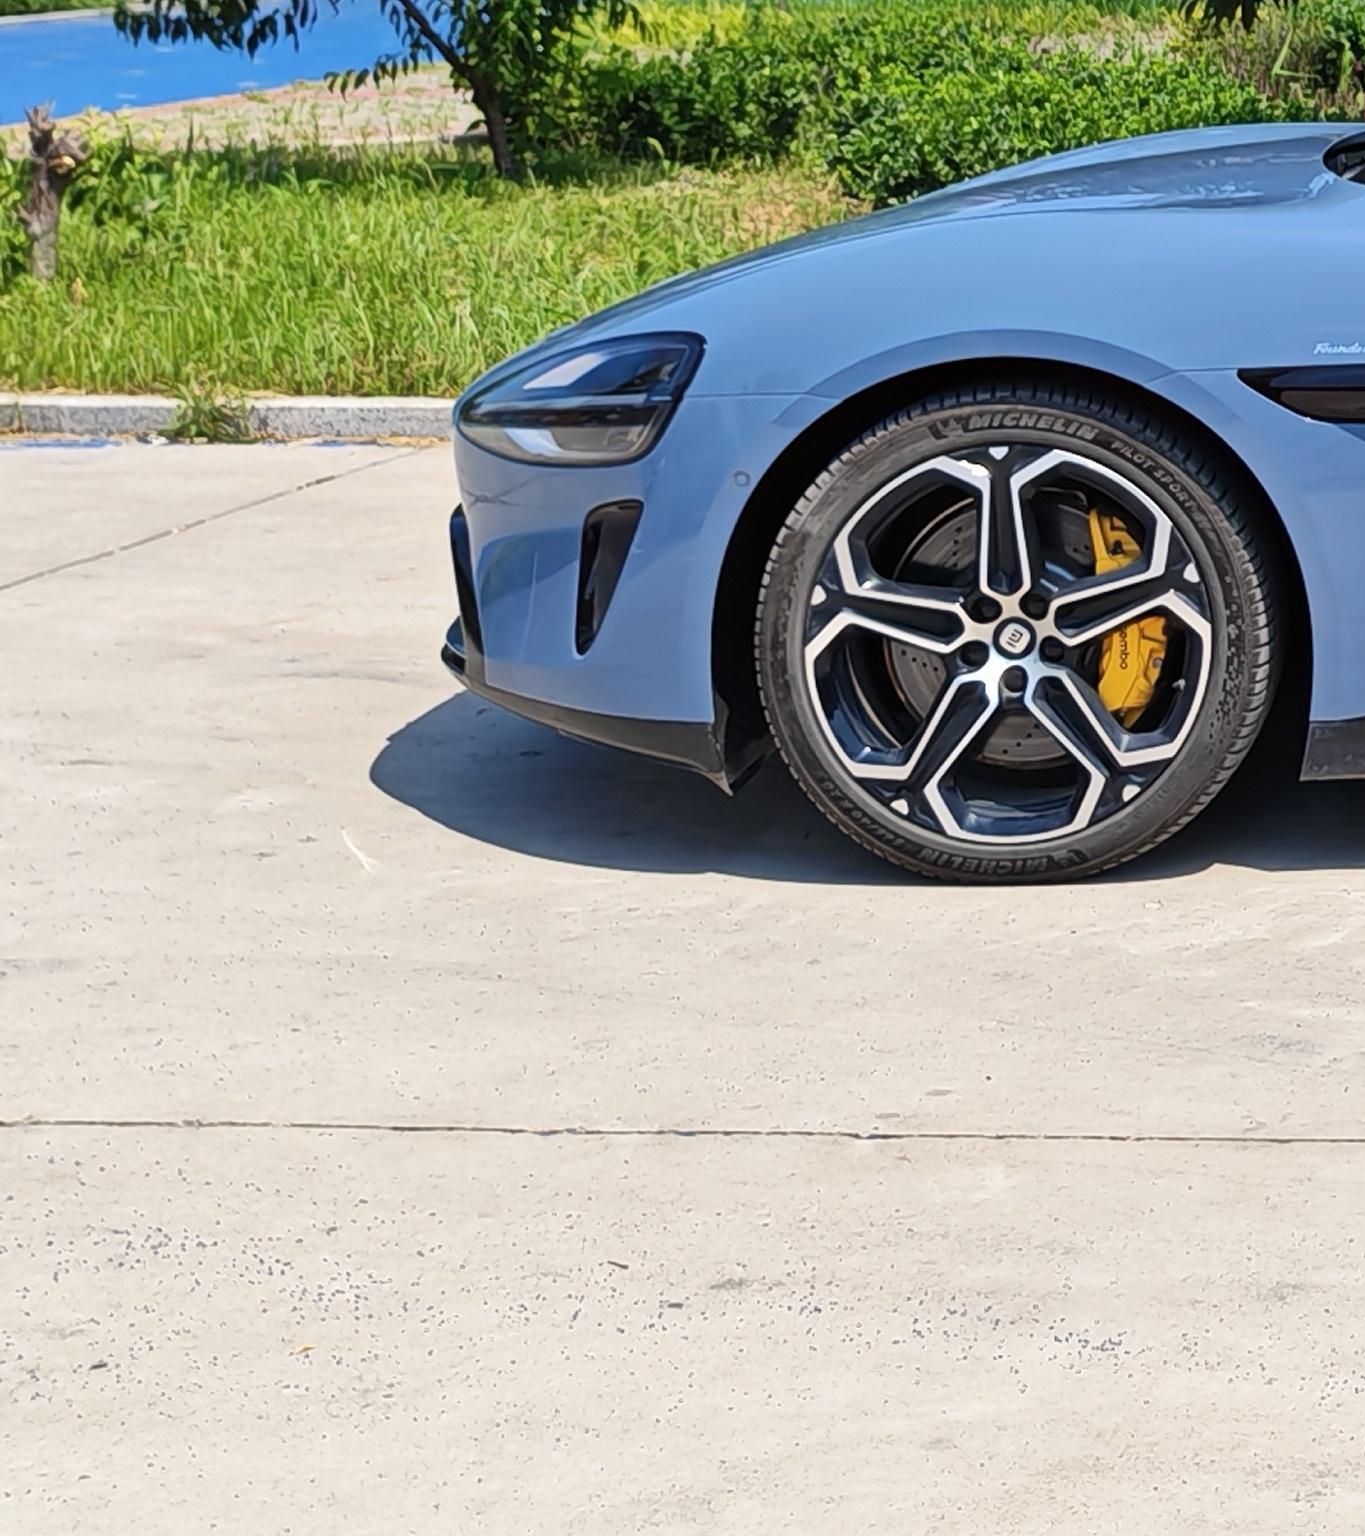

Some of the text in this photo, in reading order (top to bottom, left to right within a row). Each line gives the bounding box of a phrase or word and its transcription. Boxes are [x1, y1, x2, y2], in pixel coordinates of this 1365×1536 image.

[968, 413, 1197, 507] MICHELIN PILOT SPORT
[1119, 627, 1130, 670] embo
[917, 847, 1048, 875] MICHELIN
